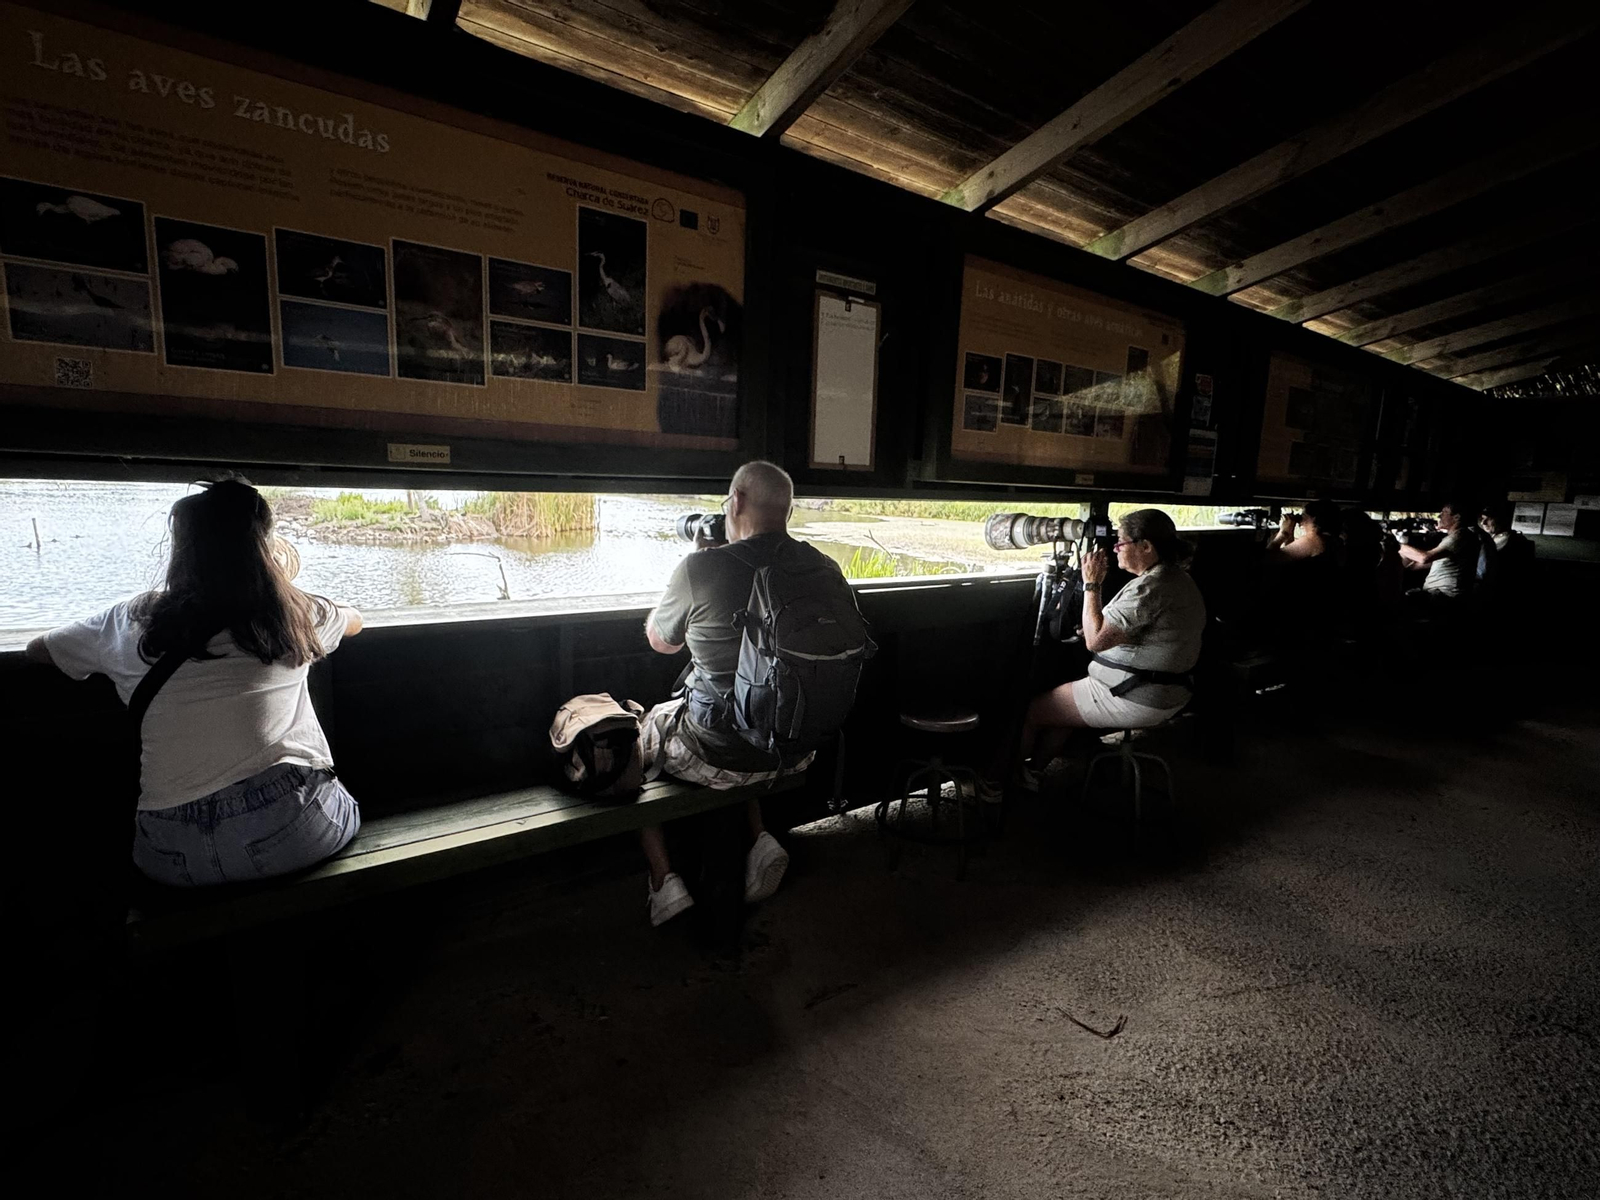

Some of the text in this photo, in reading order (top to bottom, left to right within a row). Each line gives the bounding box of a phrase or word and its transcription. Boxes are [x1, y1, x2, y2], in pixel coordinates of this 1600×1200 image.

[27, 30, 108, 82] Las
[129, 69, 216, 110] aves
[233, 94, 391, 154] zancudas
[566, 187, 649, 216] Charca de Suárez
[976, 281, 995, 300] Las
[997, 292, 1043, 313] anátidas
[1047, 302, 1054, 319] y
[1057, 306, 1082, 323] otras
[409, 449, 446, 459] Silencio
